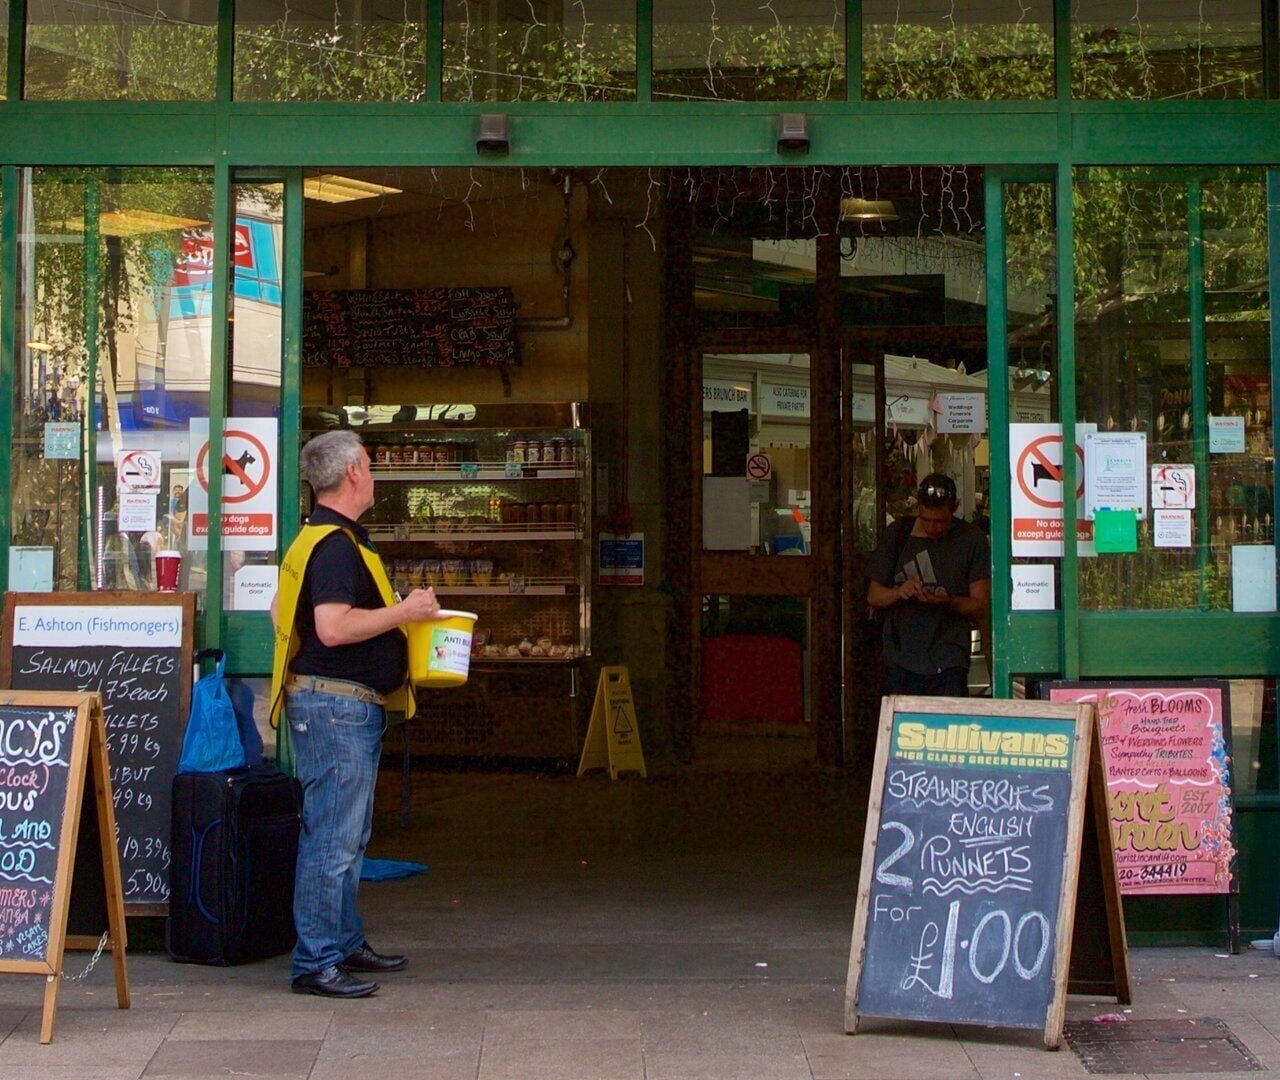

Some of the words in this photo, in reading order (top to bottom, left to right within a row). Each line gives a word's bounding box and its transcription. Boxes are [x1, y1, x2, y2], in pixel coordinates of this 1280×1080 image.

[228, 515, 249, 524] dogs
[1036, 520, 1048, 528] No
[224, 525, 247, 534] guide
[248, 525, 269, 535] dogs
[1017, 530, 1044, 540] except
[18, 617, 30, 631] E.
[35, 616, 82, 632] Ashton
[87, 616, 180, 635] (Fishmongers)
[19, 651, 103, 677] SALMON
[1150, 698, 1202, 714] BLOOMS
[897, 722, 1068, 757] Sullivans
[1169, 736, 1203, 747] FLOWERS
[895, 751, 923, 760] HIGH
[927, 753, 965, 764] CLASS
[1110, 747, 1153, 761] Sympathy
[1155, 748, 1193, 759] TRIBUTES
[888, 770, 1054, 810] STRAWBERRIES
[1182, 802, 1213, 814] 2007
[11, 819, 51, 840] AND
[947, 813, 1032, 837] ENGLISH
[876, 821, 914, 890] 2
[921, 835, 1032, 877] PUNNETS
[874, 894, 922, 921] For
